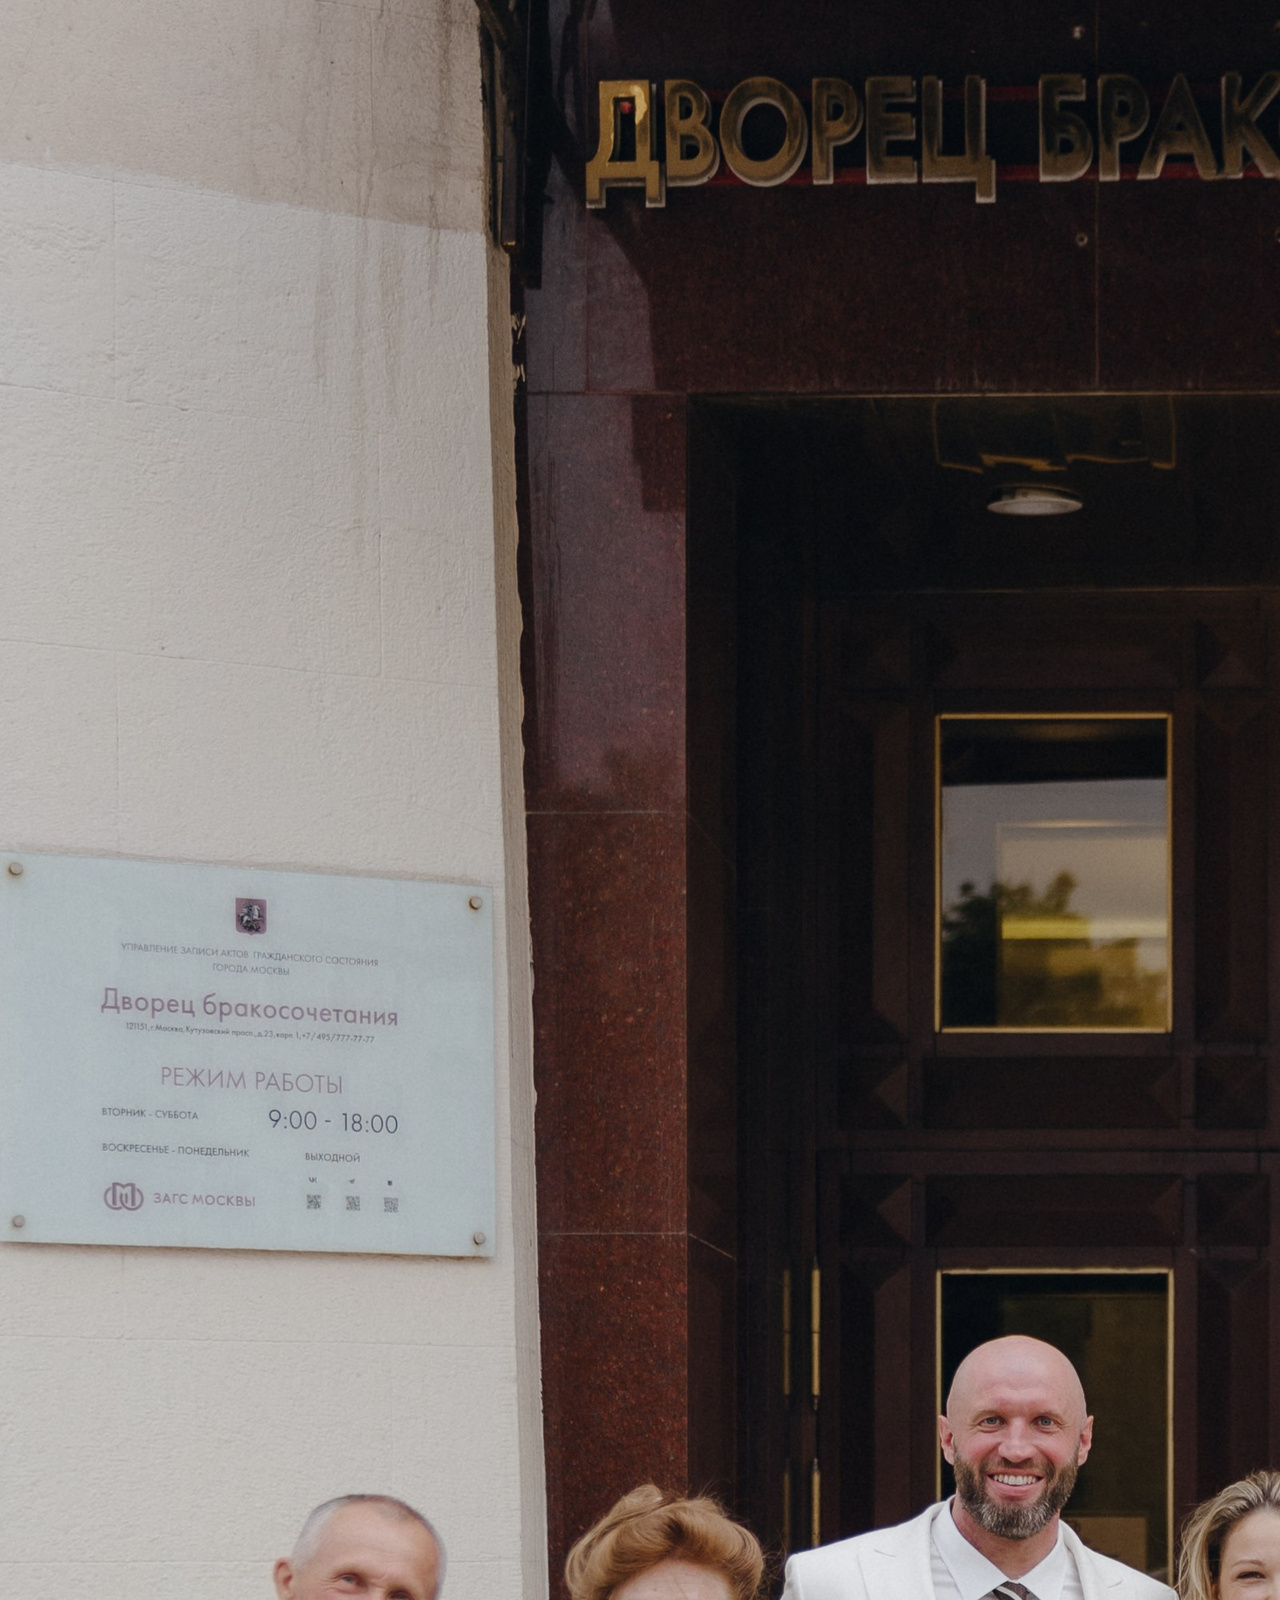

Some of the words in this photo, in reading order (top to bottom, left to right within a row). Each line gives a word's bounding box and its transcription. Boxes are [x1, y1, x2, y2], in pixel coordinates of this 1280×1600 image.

[586, 75, 996, 208] ДВОРЕЦ
[121, 942, 178, 954] УПРАВЛЕНИЕ
[180, 946, 219, 957] ЗАПИСИ
[220, 949, 249, 959] АКТОВ
[253, 950, 323, 963] ГРАЖДАНСКОГО
[325, 955, 379, 967] СОСТОЯНИЯ
[212, 962, 248, 973] ГОРОДА
[250, 965, 290, 976] МОСКВЫ
[101, 987, 195, 1019] Дворец
[203, 992, 398, 1026] бракосочетания
[161, 1066, 247, 1090] РЕЖИМ
[255, 1071, 343, 1094] РАБОТЫ
[102, 1107, 146, 1118] ВТОРНИК
[155, 1109, 199, 1120] СУББОТА
[269, 1109, 317, 1130] 9:00
[342, 1112, 398, 1134] 18:00
[102, 1143, 169, 1154] ВОСКРЕСЕНЬЕ
[178, 1146, 250, 1158] ПОНЕДЕЛЬНИК
[305, 1152, 361, 1163] ВЫХОДНОЙ
[153, 1192, 188, 1205] ЗАГС
[191, 1194, 256, 1207] МОСКВЫ
